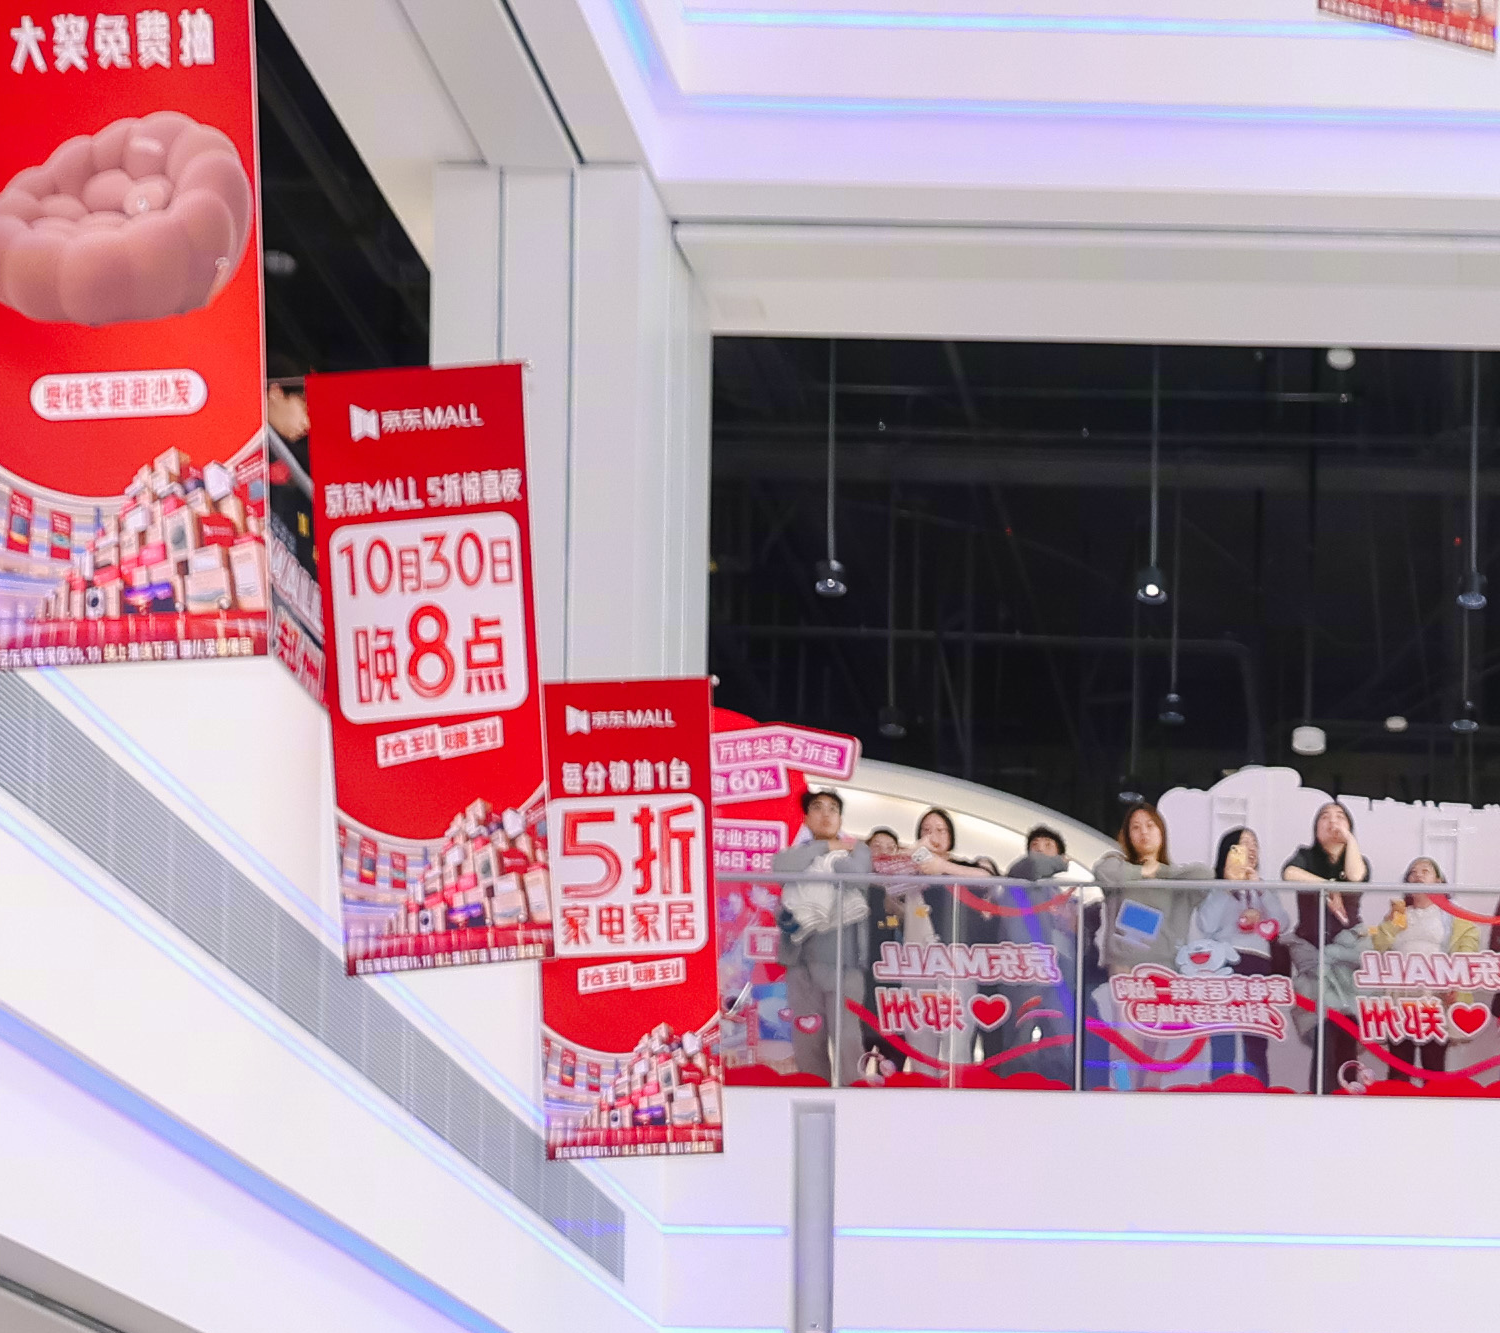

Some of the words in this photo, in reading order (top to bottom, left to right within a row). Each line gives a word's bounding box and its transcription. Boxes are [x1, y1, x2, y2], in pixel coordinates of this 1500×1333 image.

[10, 9, 215, 75] 大奖免费抽
[381, 403, 484, 433] 京东MALL
[324, 476, 425, 519] 京东MALL
[426, 468, 522, 507] 5折惊喜夜
[337, 528, 513, 596] 10月30日
[355, 604, 507, 704] 晚8点
[591, 709, 676, 729] 京东MALL
[562, 758, 692, 793] 每分钟抽1台
[561, 804, 695, 899] 5折
[561, 903, 697, 945] 家电家居
